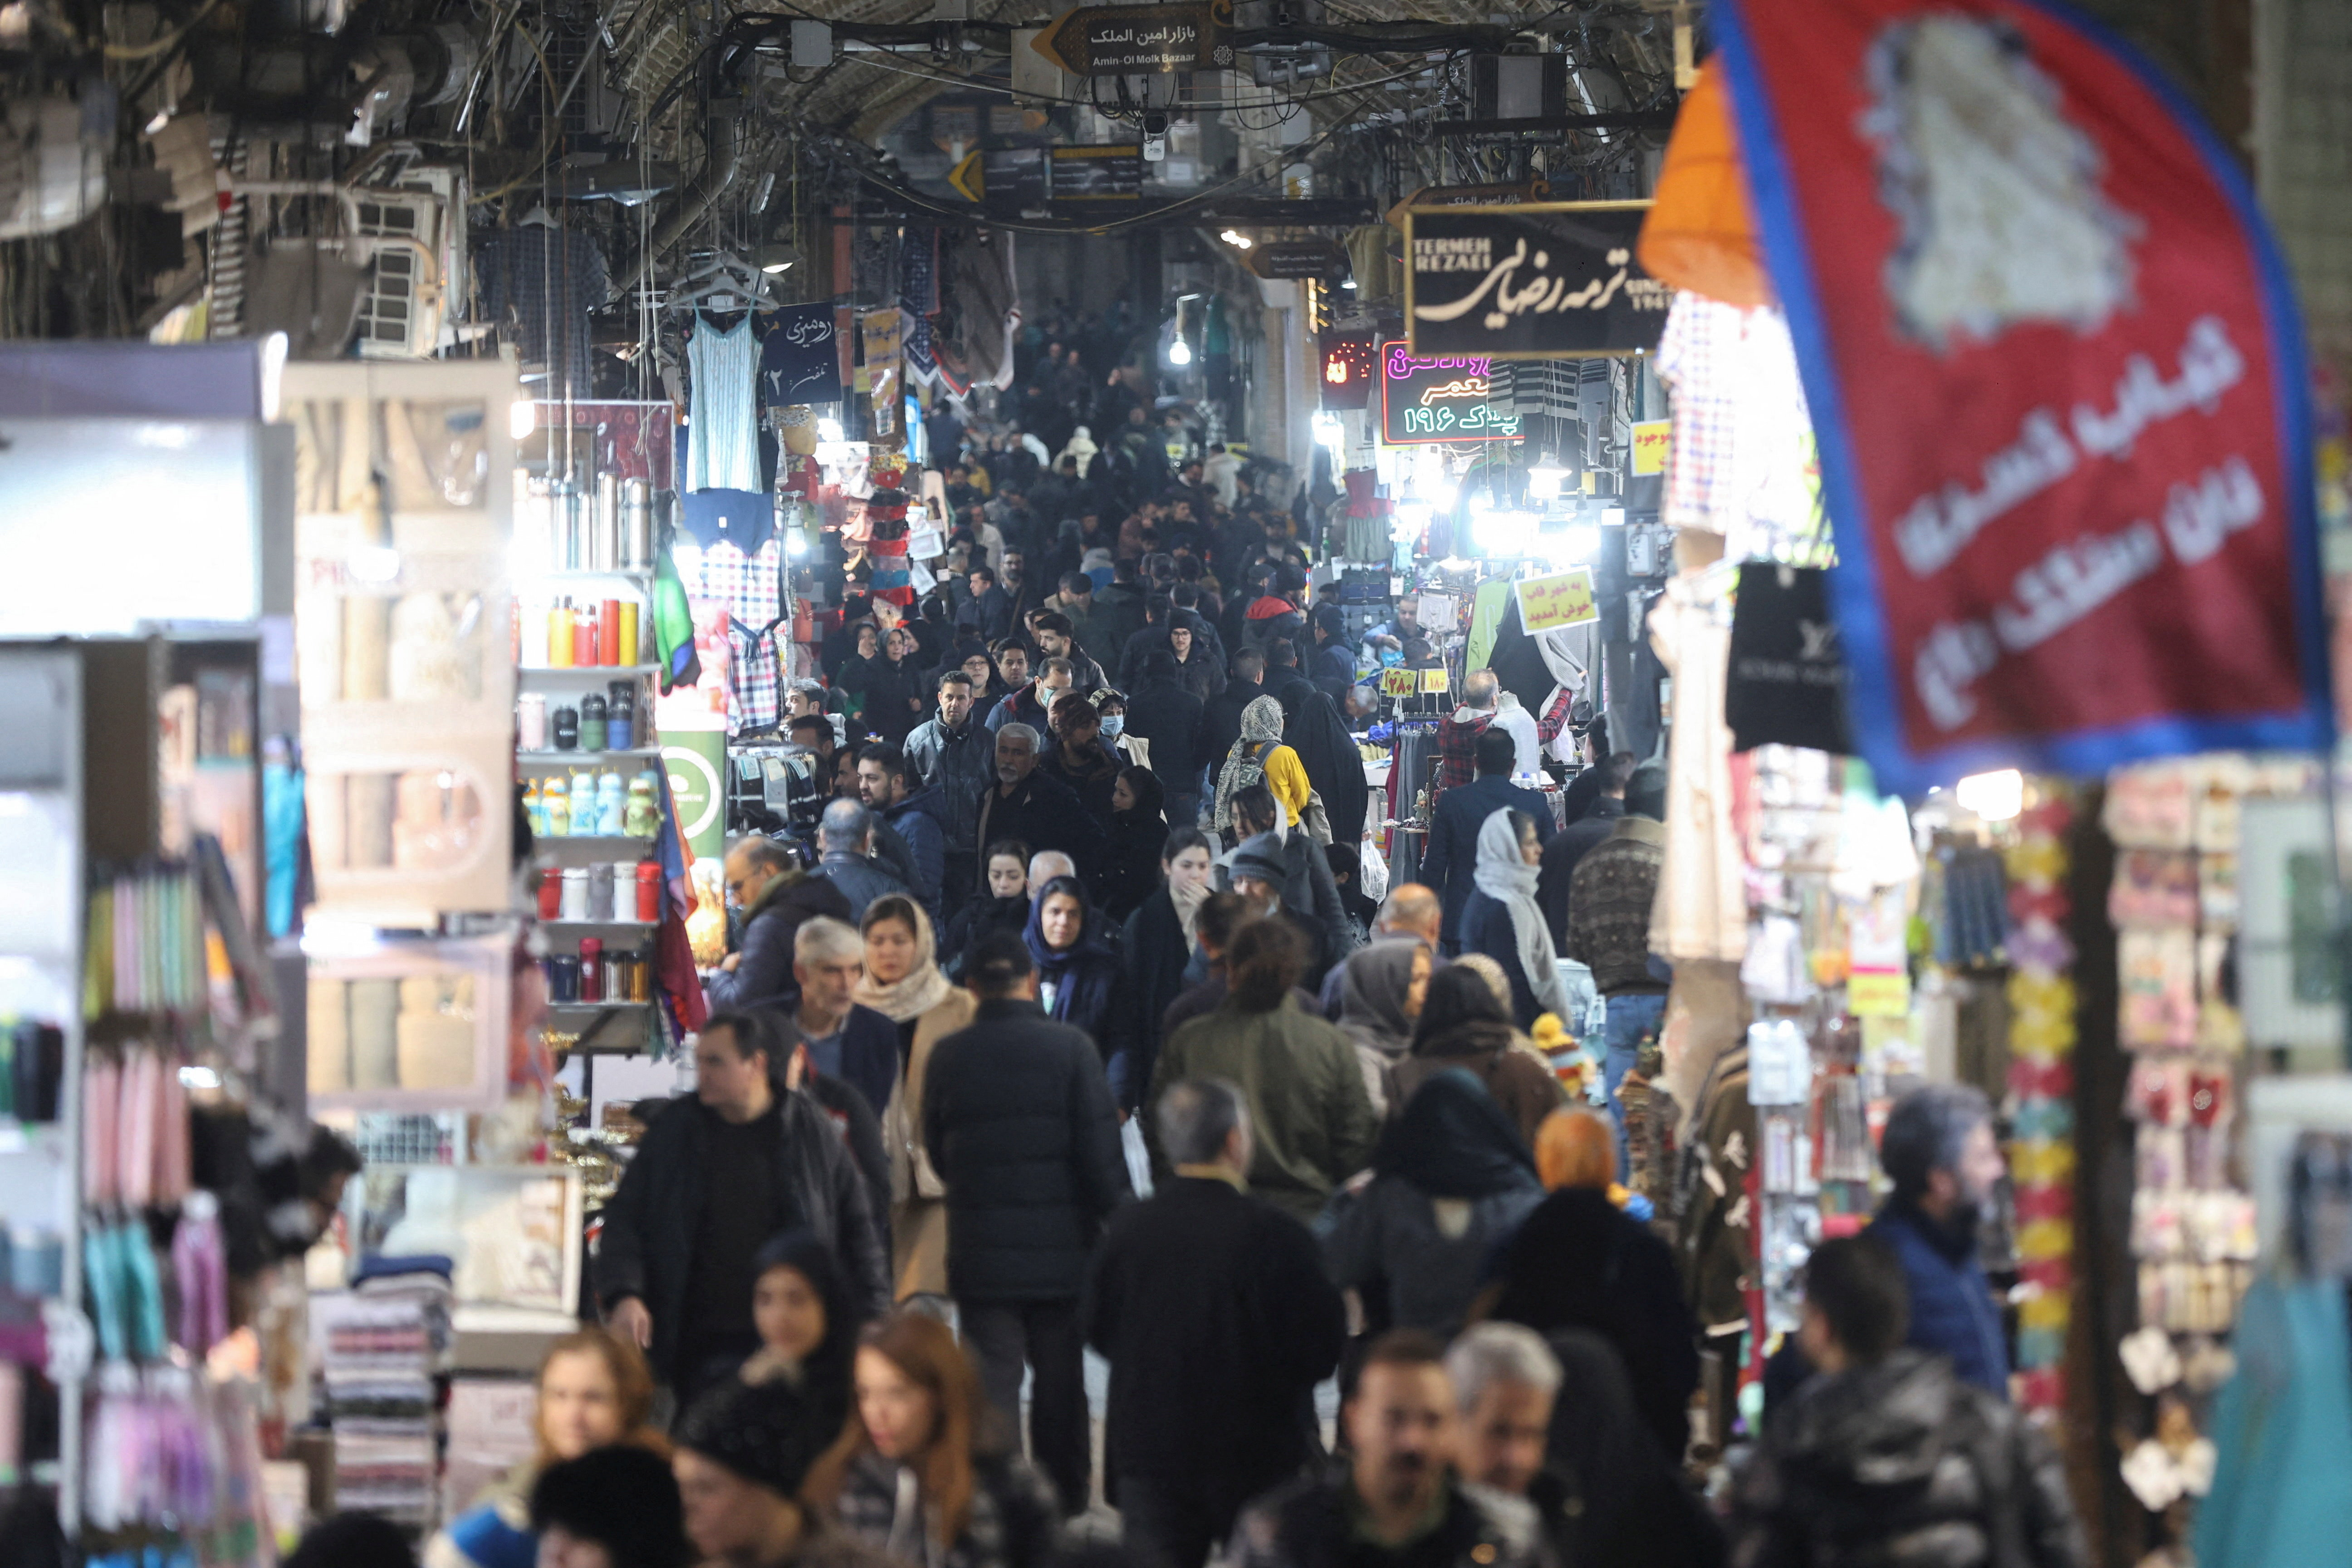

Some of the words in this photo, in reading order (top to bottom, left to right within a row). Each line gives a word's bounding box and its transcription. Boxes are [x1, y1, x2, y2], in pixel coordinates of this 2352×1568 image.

[1091, 29, 1133, 43] الملک
[1137, 26, 1167, 46] امین
[1168, 25, 1196, 44] بازار
[1093, 55, 1134, 66] Amin-Ol
[1136, 54, 1160, 64] Molk
[1161, 53, 1196, 63] Bazaar
[1414, 238, 1492, 254] TERMEH
[1415, 254, 1492, 270] REZAEI
[1558, 248, 1630, 313] ترمه
[786, 315, 832, 348] رومیزی
[1404, 407, 1455, 432] ۱۹۶
[1563, 600, 1589, 618] خوش
[1389, 677, 1412, 694] ۲۸۰
[1430, 677, 1444, 690] ۱۸۰
